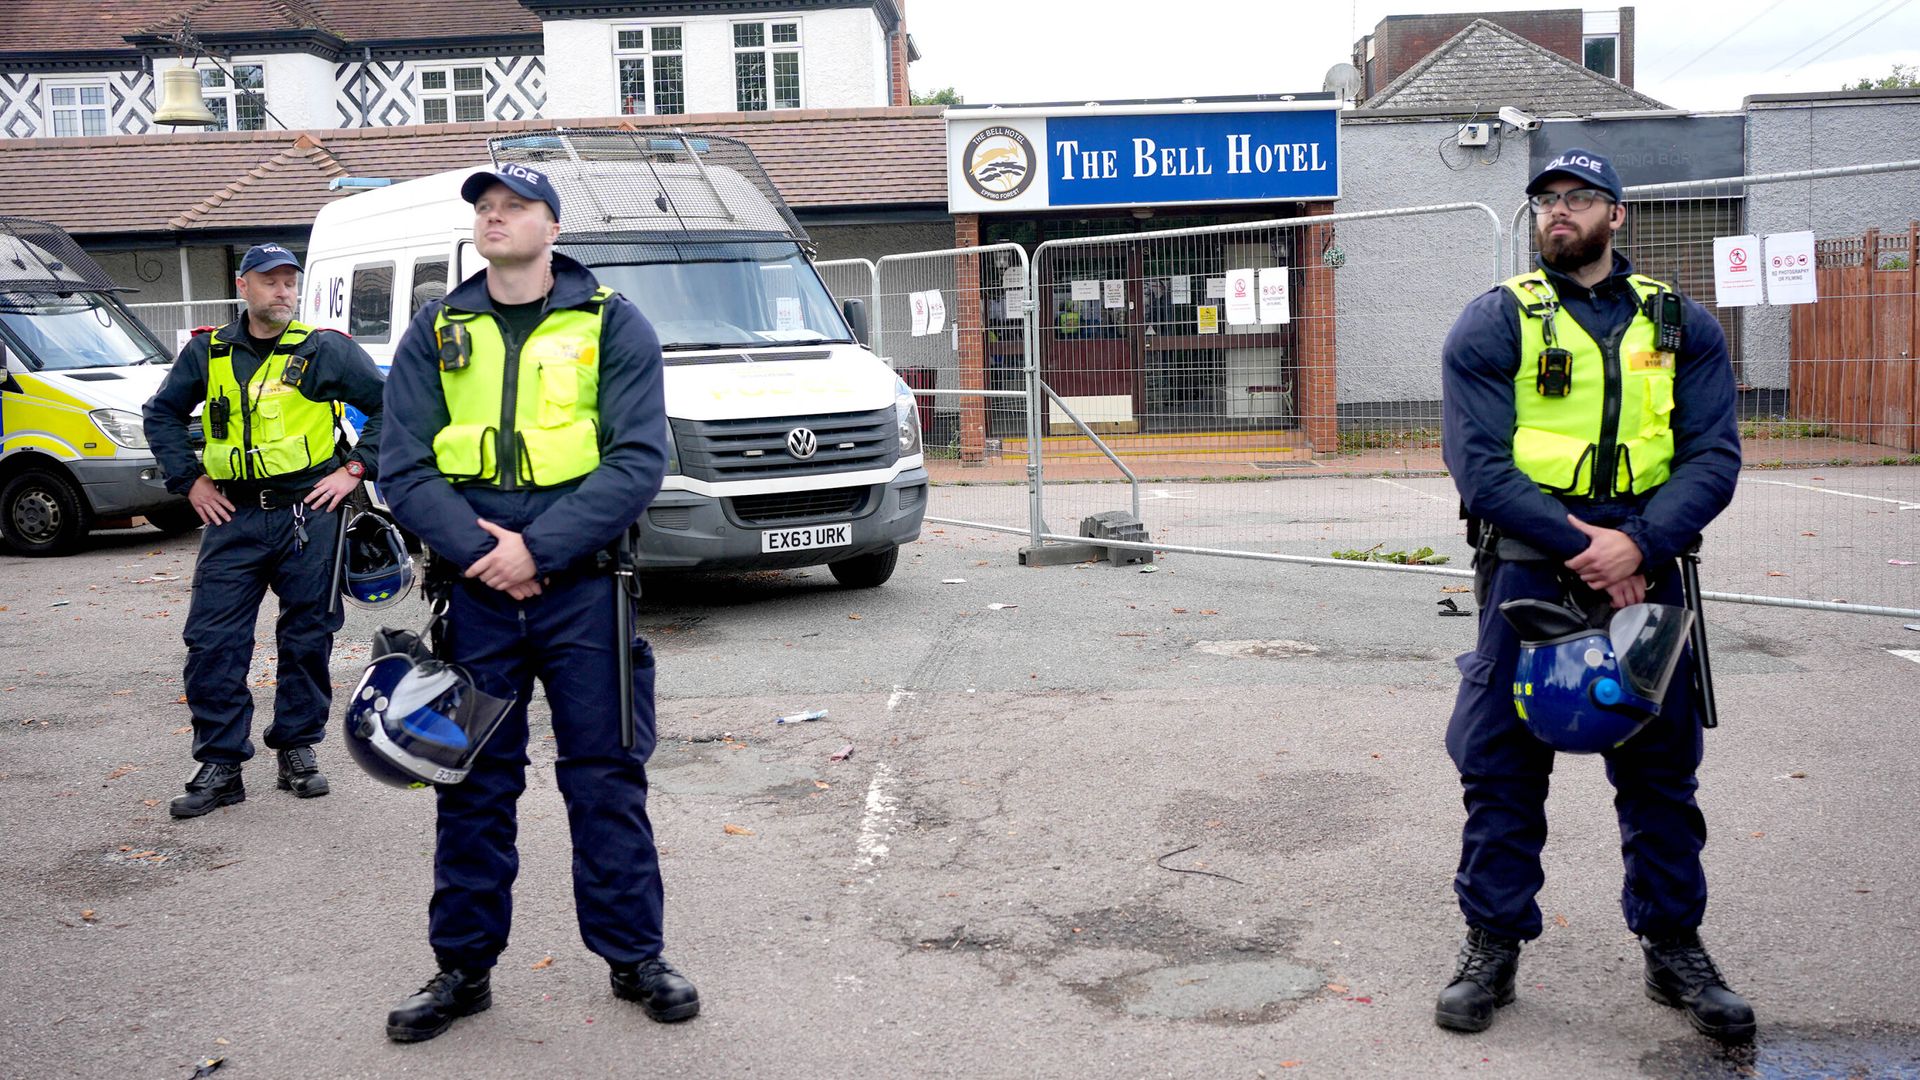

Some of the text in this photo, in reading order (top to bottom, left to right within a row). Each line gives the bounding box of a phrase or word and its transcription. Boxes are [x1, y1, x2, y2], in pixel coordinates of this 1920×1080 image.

[972, 128, 1025, 145] THE BELL HOTEL
[1545, 155, 1603, 174] OLICE
[981, 188, 1020, 200] EPPING FOREST
[329, 276, 345, 318] VG
[769, 526, 846, 550] EX63 URK
